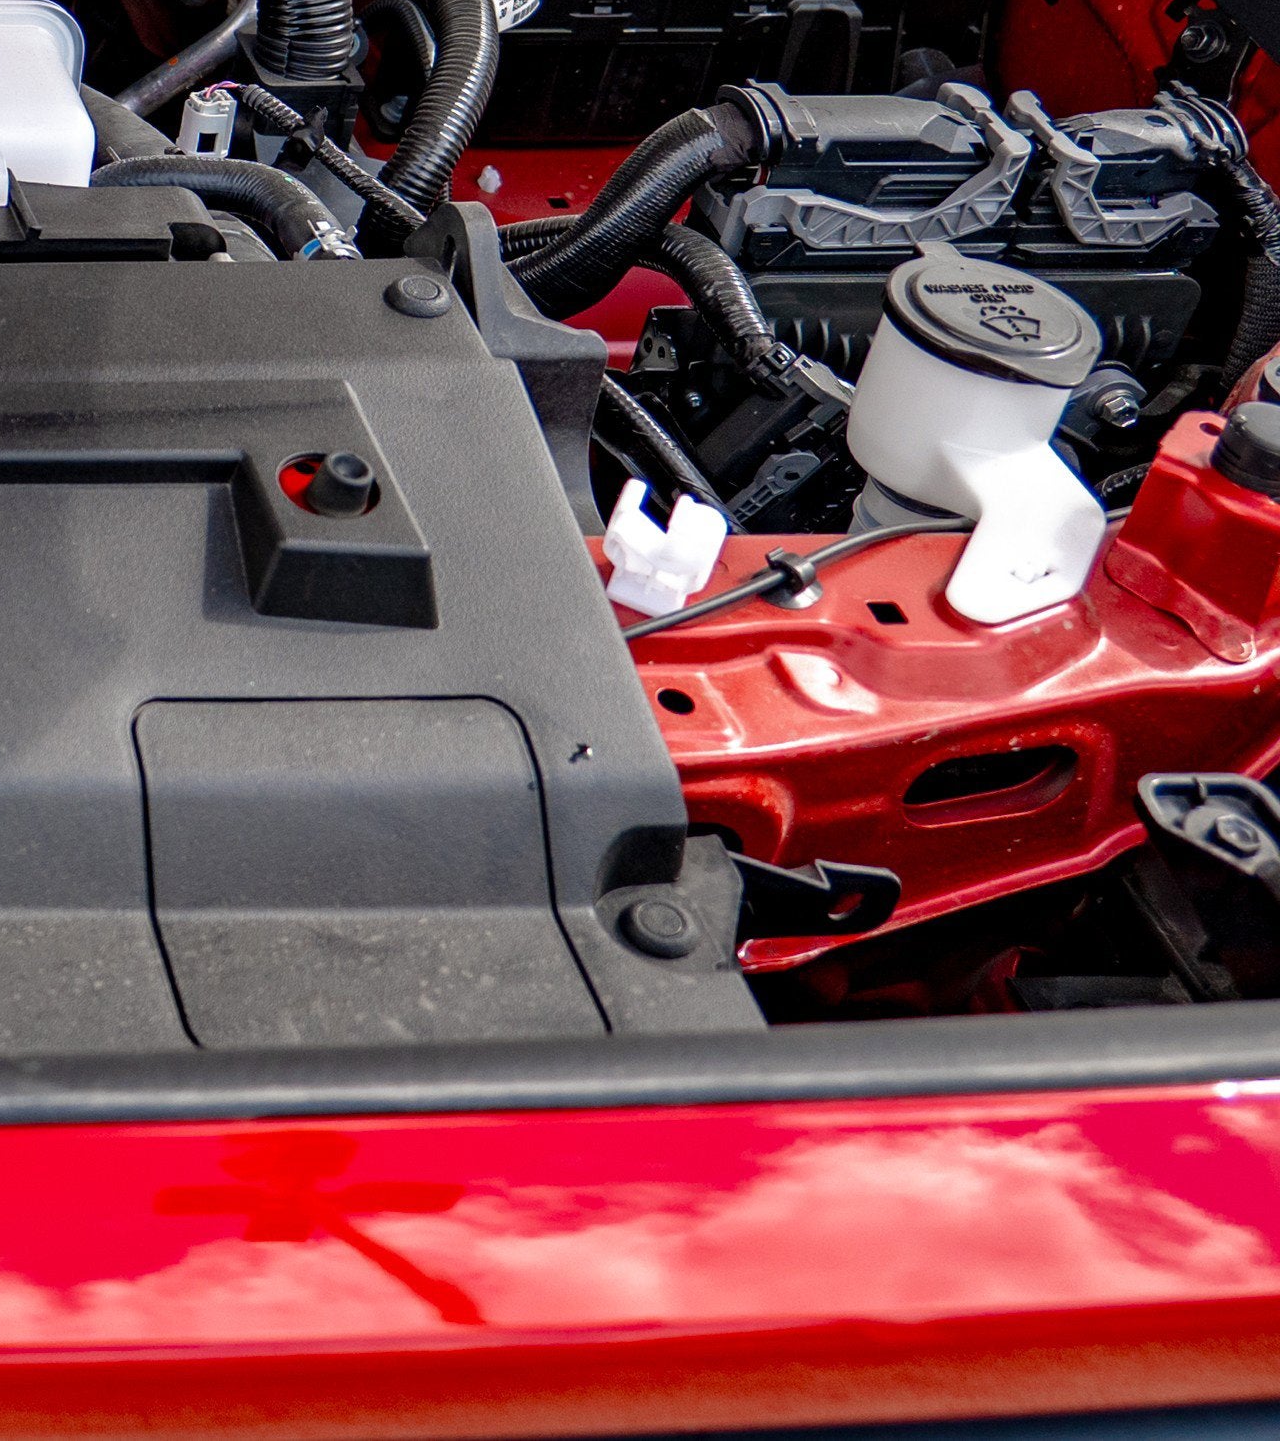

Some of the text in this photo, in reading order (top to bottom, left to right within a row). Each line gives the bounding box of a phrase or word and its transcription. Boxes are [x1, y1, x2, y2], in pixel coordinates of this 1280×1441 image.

[923, 283, 1035, 295] WASHER FLUID
[969, 293, 1008, 303] ONLY
